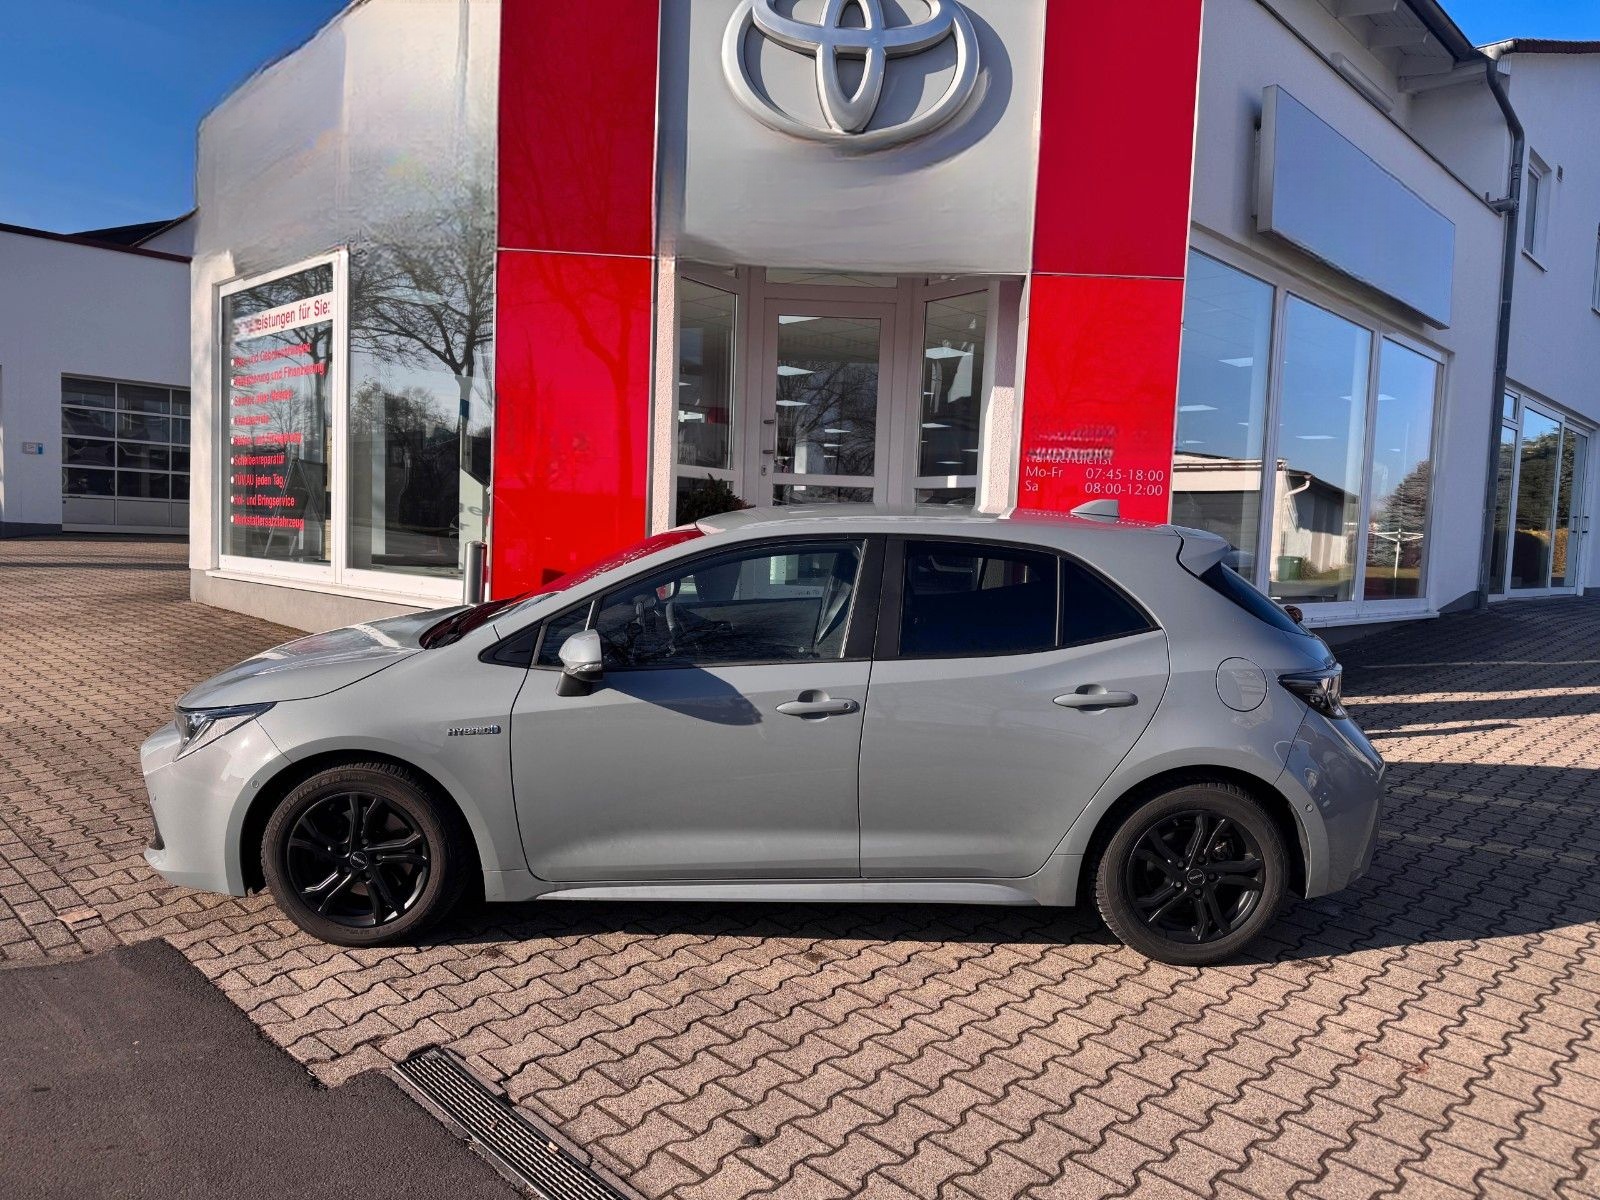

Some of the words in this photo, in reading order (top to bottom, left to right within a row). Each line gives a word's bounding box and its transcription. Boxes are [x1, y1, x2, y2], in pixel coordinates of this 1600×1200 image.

[299, 303, 311, 321] für
[314, 299, 331, 316] Sie:
[255, 474, 272, 489] jeden
[272, 473, 285, 489] Tag
[1025, 466, 1064, 479] Mo-Fr
[1085, 467, 1164, 482] 07:45-18:00
[1025, 480, 1039, 492] Sa
[1084, 482, 1163, 497] 08:00-12:00
[246, 494, 257, 507] und
[257, 494, 296, 509] Bringservice
